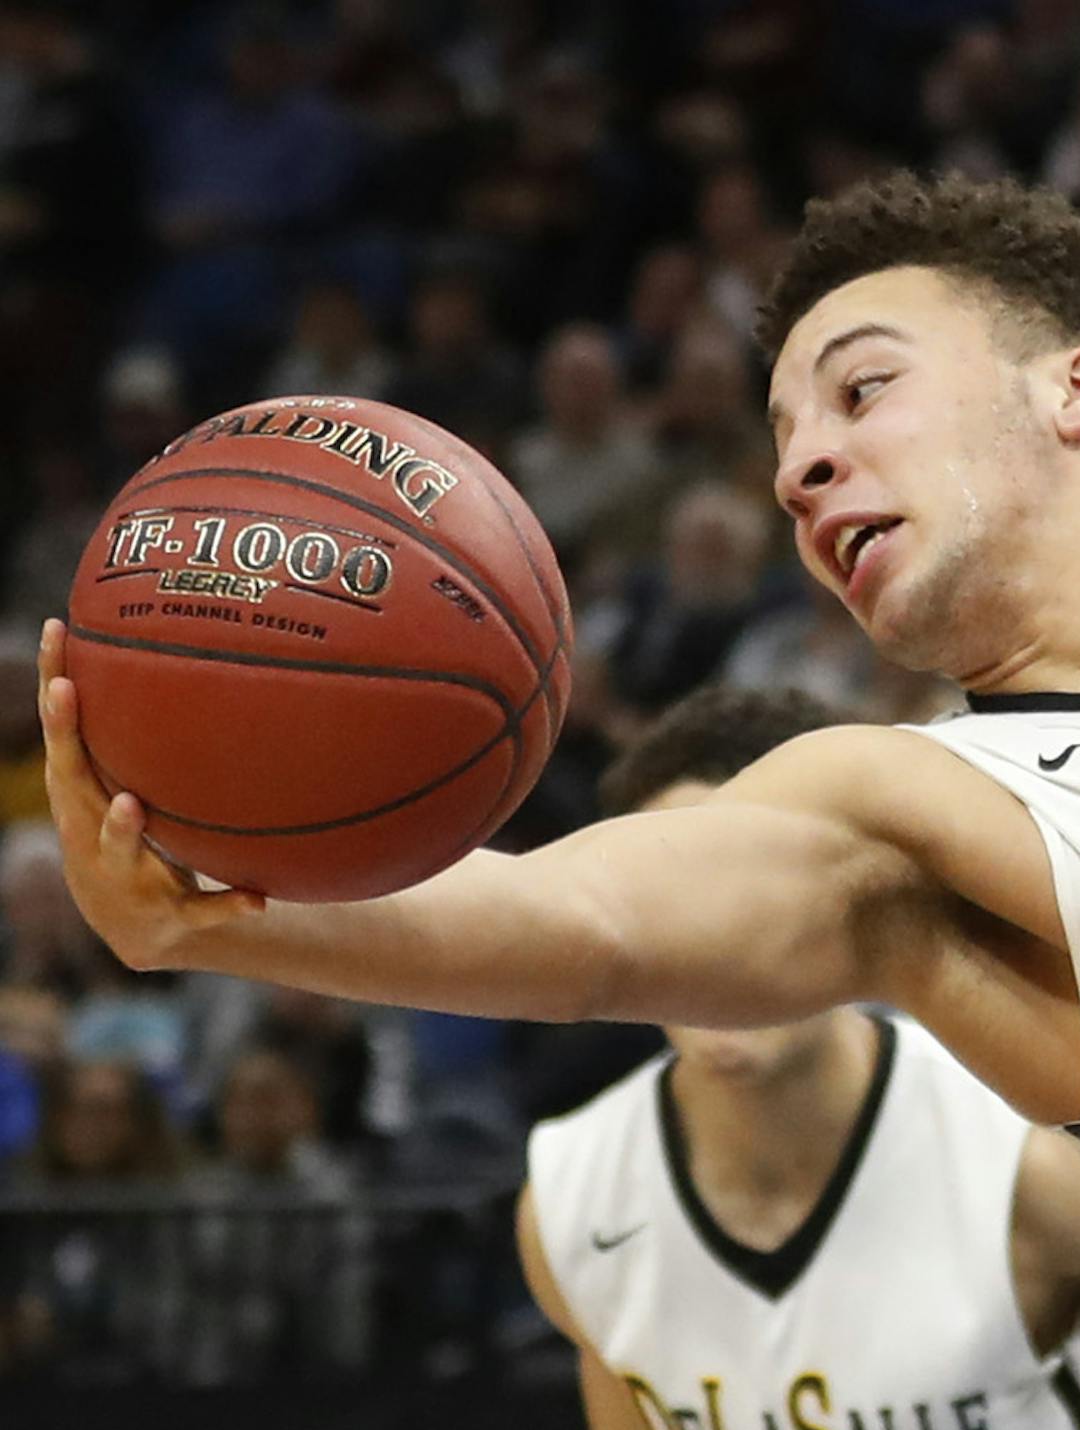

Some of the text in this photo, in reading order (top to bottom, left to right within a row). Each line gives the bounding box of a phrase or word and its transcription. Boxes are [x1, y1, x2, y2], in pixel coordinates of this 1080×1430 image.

[157, 569, 279, 604] LEGACY
[119, 602, 328, 641] DEEP CHANNEL DESIGN
